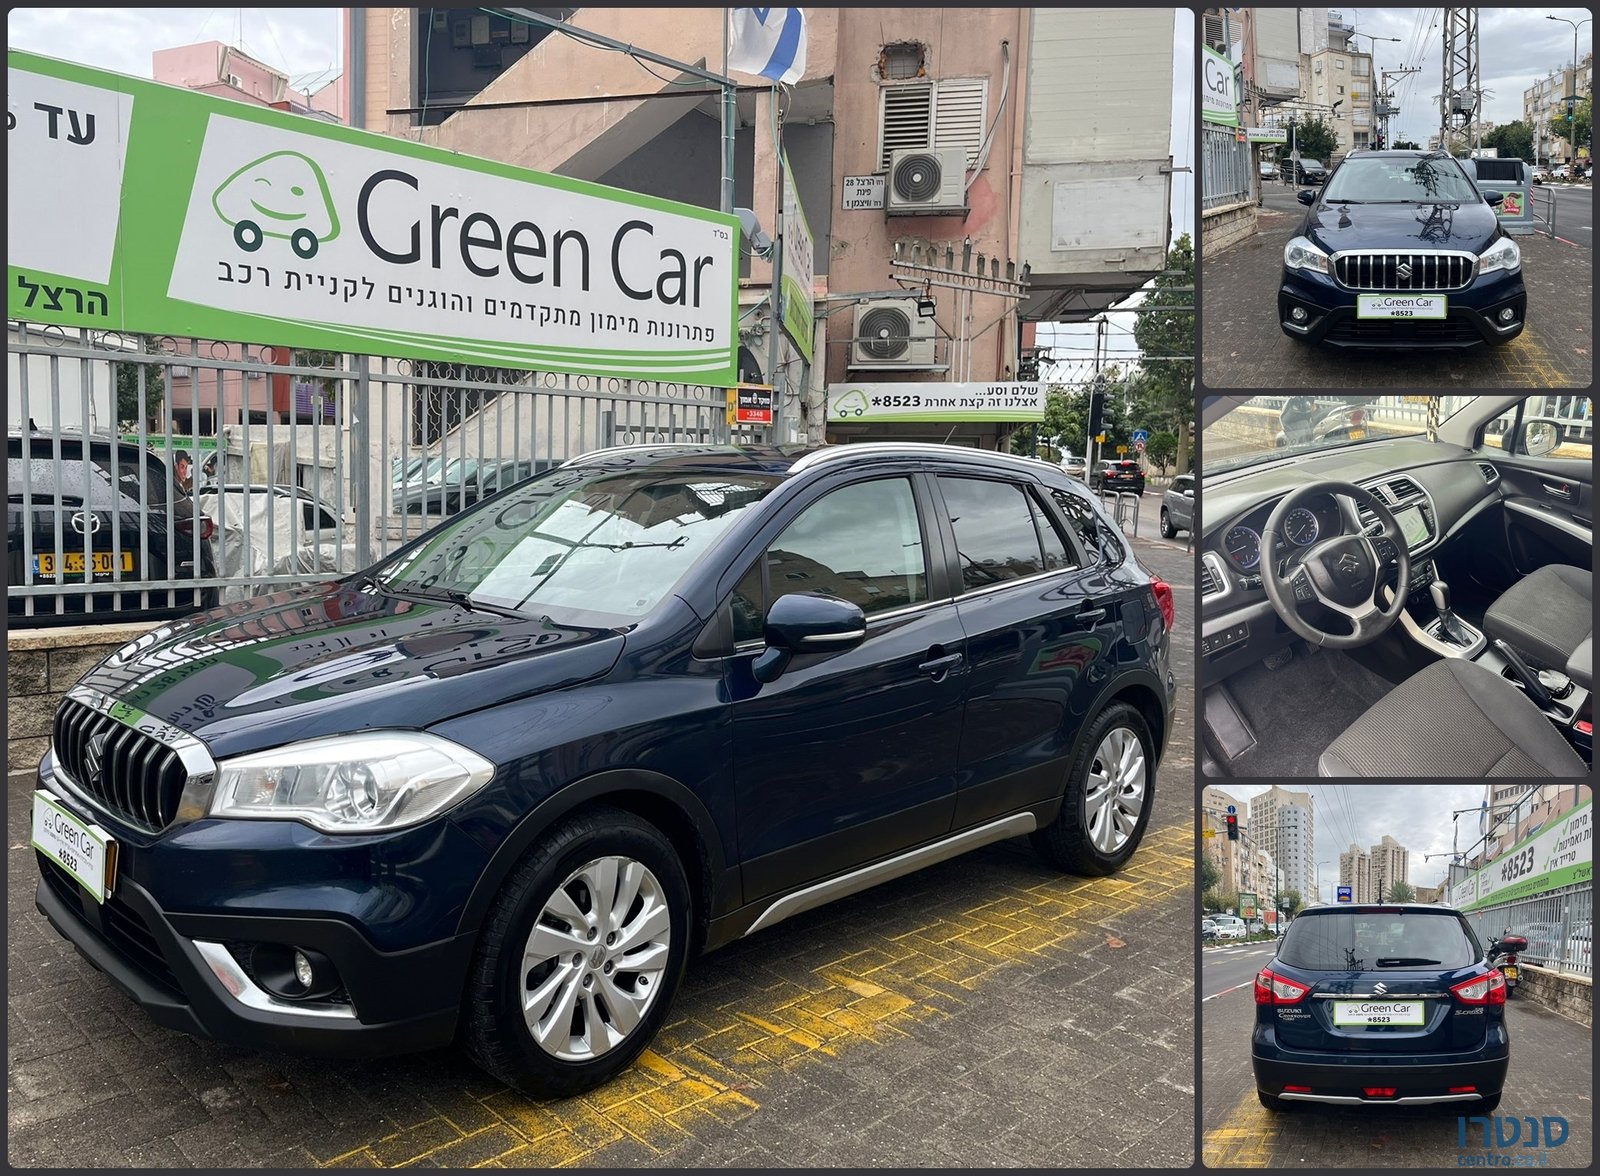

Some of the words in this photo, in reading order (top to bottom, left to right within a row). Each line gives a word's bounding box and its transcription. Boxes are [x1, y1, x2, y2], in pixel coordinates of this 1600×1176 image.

[1205, 58, 1230, 97] Car
[33, 102, 96, 146] עד
[357, 169, 590, 292] Green
[611, 220, 714, 308] Car
[218, 261, 270, 287] רכב
[17, 275, 108, 317] הרצל
[284, 270, 375, 304] לקניית
[388, 285, 474, 314] והוגנים
[1384, 298, 1414, 307] Green
[1416, 298, 1434, 307] Car
[485, 298, 581, 328] מתקדמים
[590, 312, 639, 334] מימון
[646, 320, 715, 343] פתרונות
[924, 396, 956, 407] אחרת
[988, 396, 1000, 407] זה
[1004, 396, 1038, 406] אצלנו
[1011, 386, 1038, 396] שלם
[959, 396, 985, 410] קצת
[54, 813, 80, 848] Green
[80, 832, 94, 860] Car
[1570, 814, 1588, 836] מימון
[1360, 1003, 1392, 1013] Green
[1395, 1003, 1411, 1013] Car
